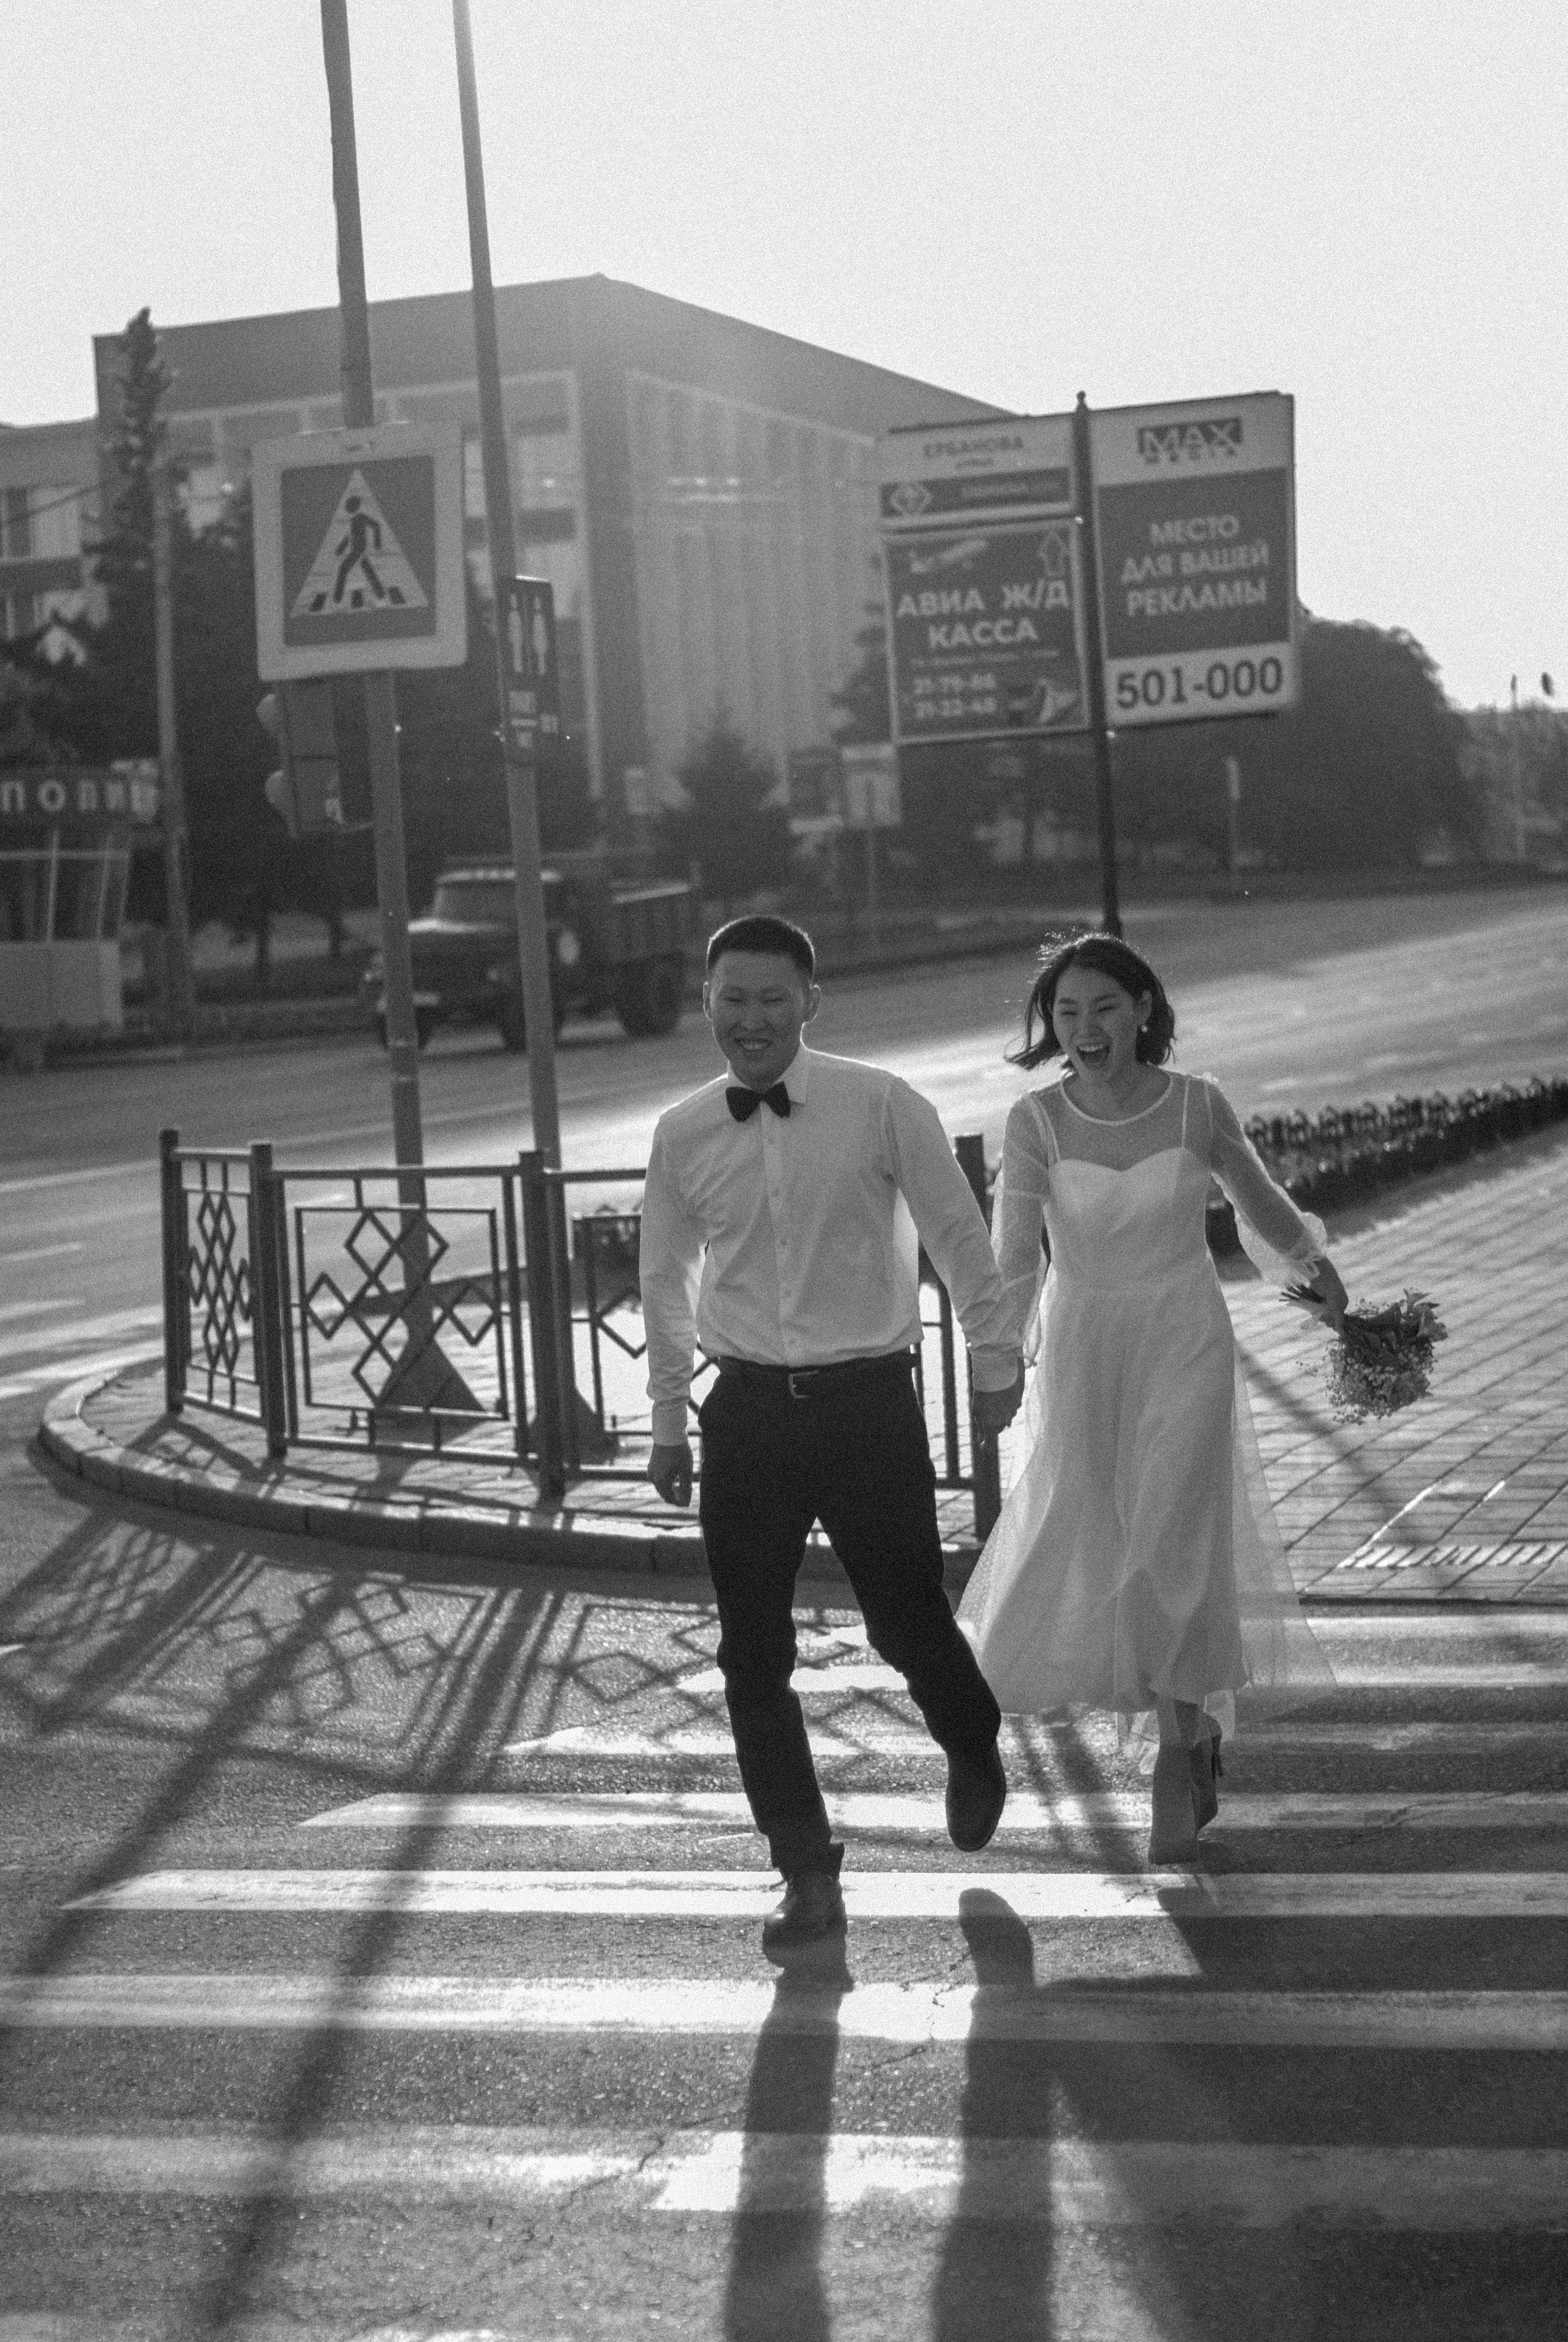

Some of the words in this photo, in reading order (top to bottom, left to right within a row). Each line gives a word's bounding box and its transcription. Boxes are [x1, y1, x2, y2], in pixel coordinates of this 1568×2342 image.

[1142, 420, 1241, 455] MAX
[1150, 515, 1240, 546] МЕСТО
[1121, 555, 1174, 584] ДЛЯ
[1180, 538, 1270, 575] ВАШЕЙ
[896, 588, 986, 617] АВИА
[1001, 579, 1070, 610] Ж/Д
[1127, 578, 1267, 617] РЕКЛАМЫ
[929, 617, 1039, 649] КАССА
[1117, 656, 1283, 709] 501-000
